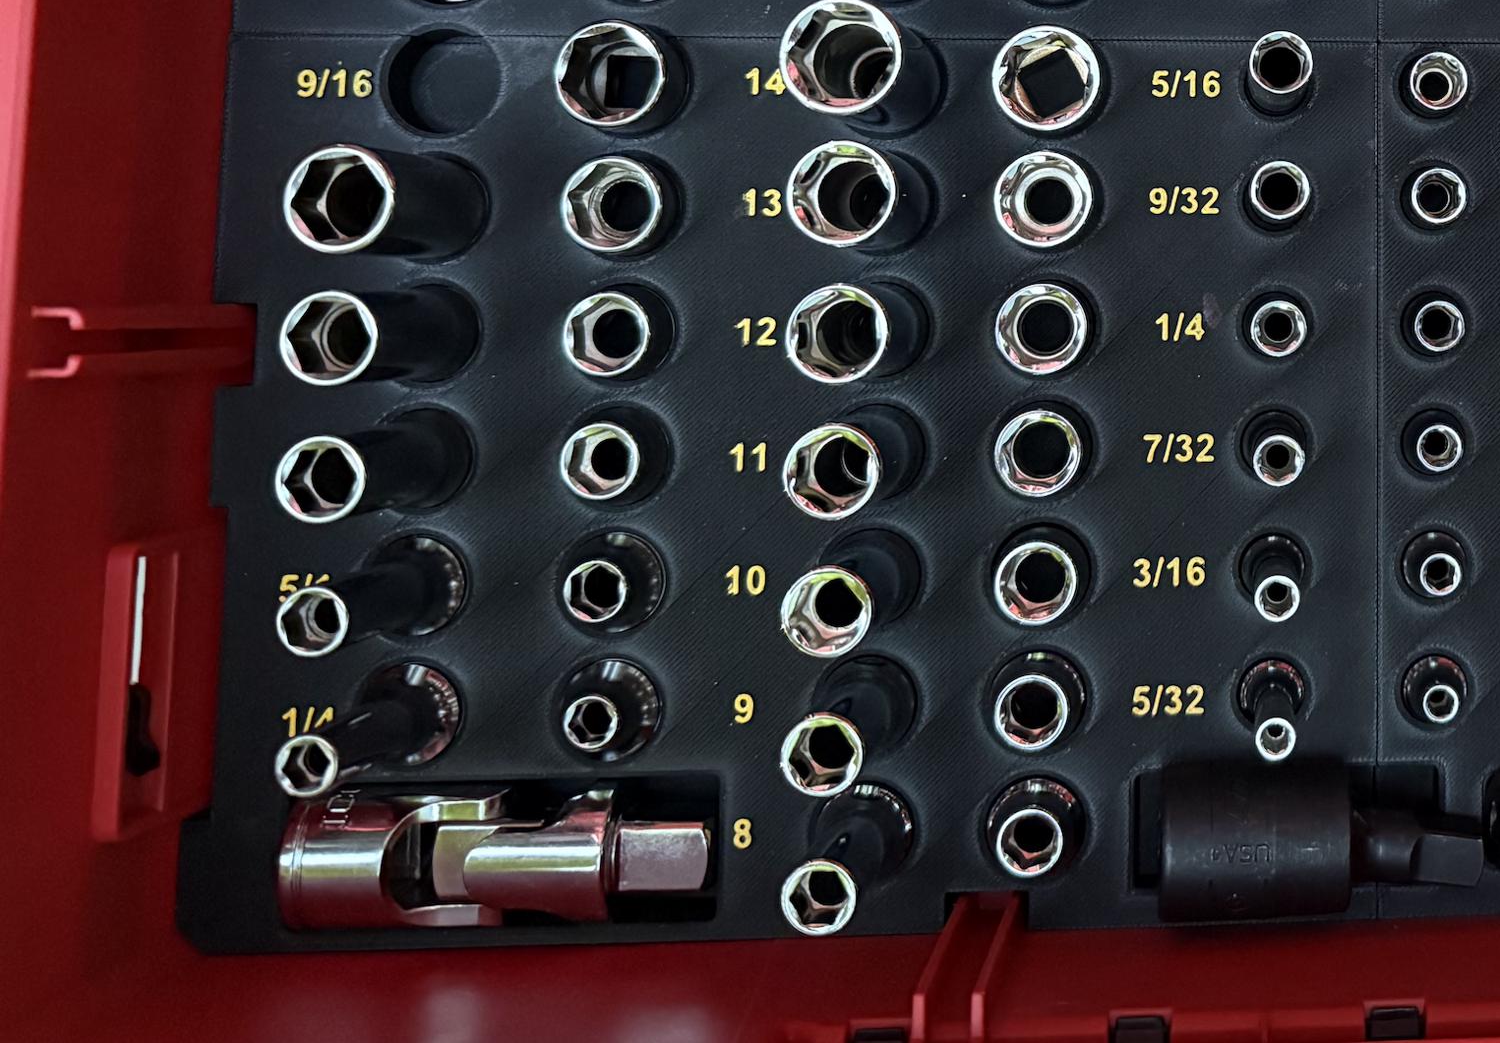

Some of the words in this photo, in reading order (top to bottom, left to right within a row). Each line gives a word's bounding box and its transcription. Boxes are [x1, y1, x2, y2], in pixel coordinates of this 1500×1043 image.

[296, 68, 372, 98] 9/16
[747, 68, 788, 96] 14
[1151, 69, 1221, 98] 5/16
[744, 188, 782, 217] 13
[1148, 187, 1220, 215] 9/32
[737, 318, 778, 347] 12
[1155, 312, 1206, 342] 1/4
[731, 443, 767, 473] 11
[1143, 433, 1215, 464] 7/32
[727, 564, 766, 597] 10
[1132, 557, 1206, 588] 3/16
[733, 694, 754, 725] 9
[1131, 684, 1204, 717] 5/32
[732, 818, 752, 850] 8
